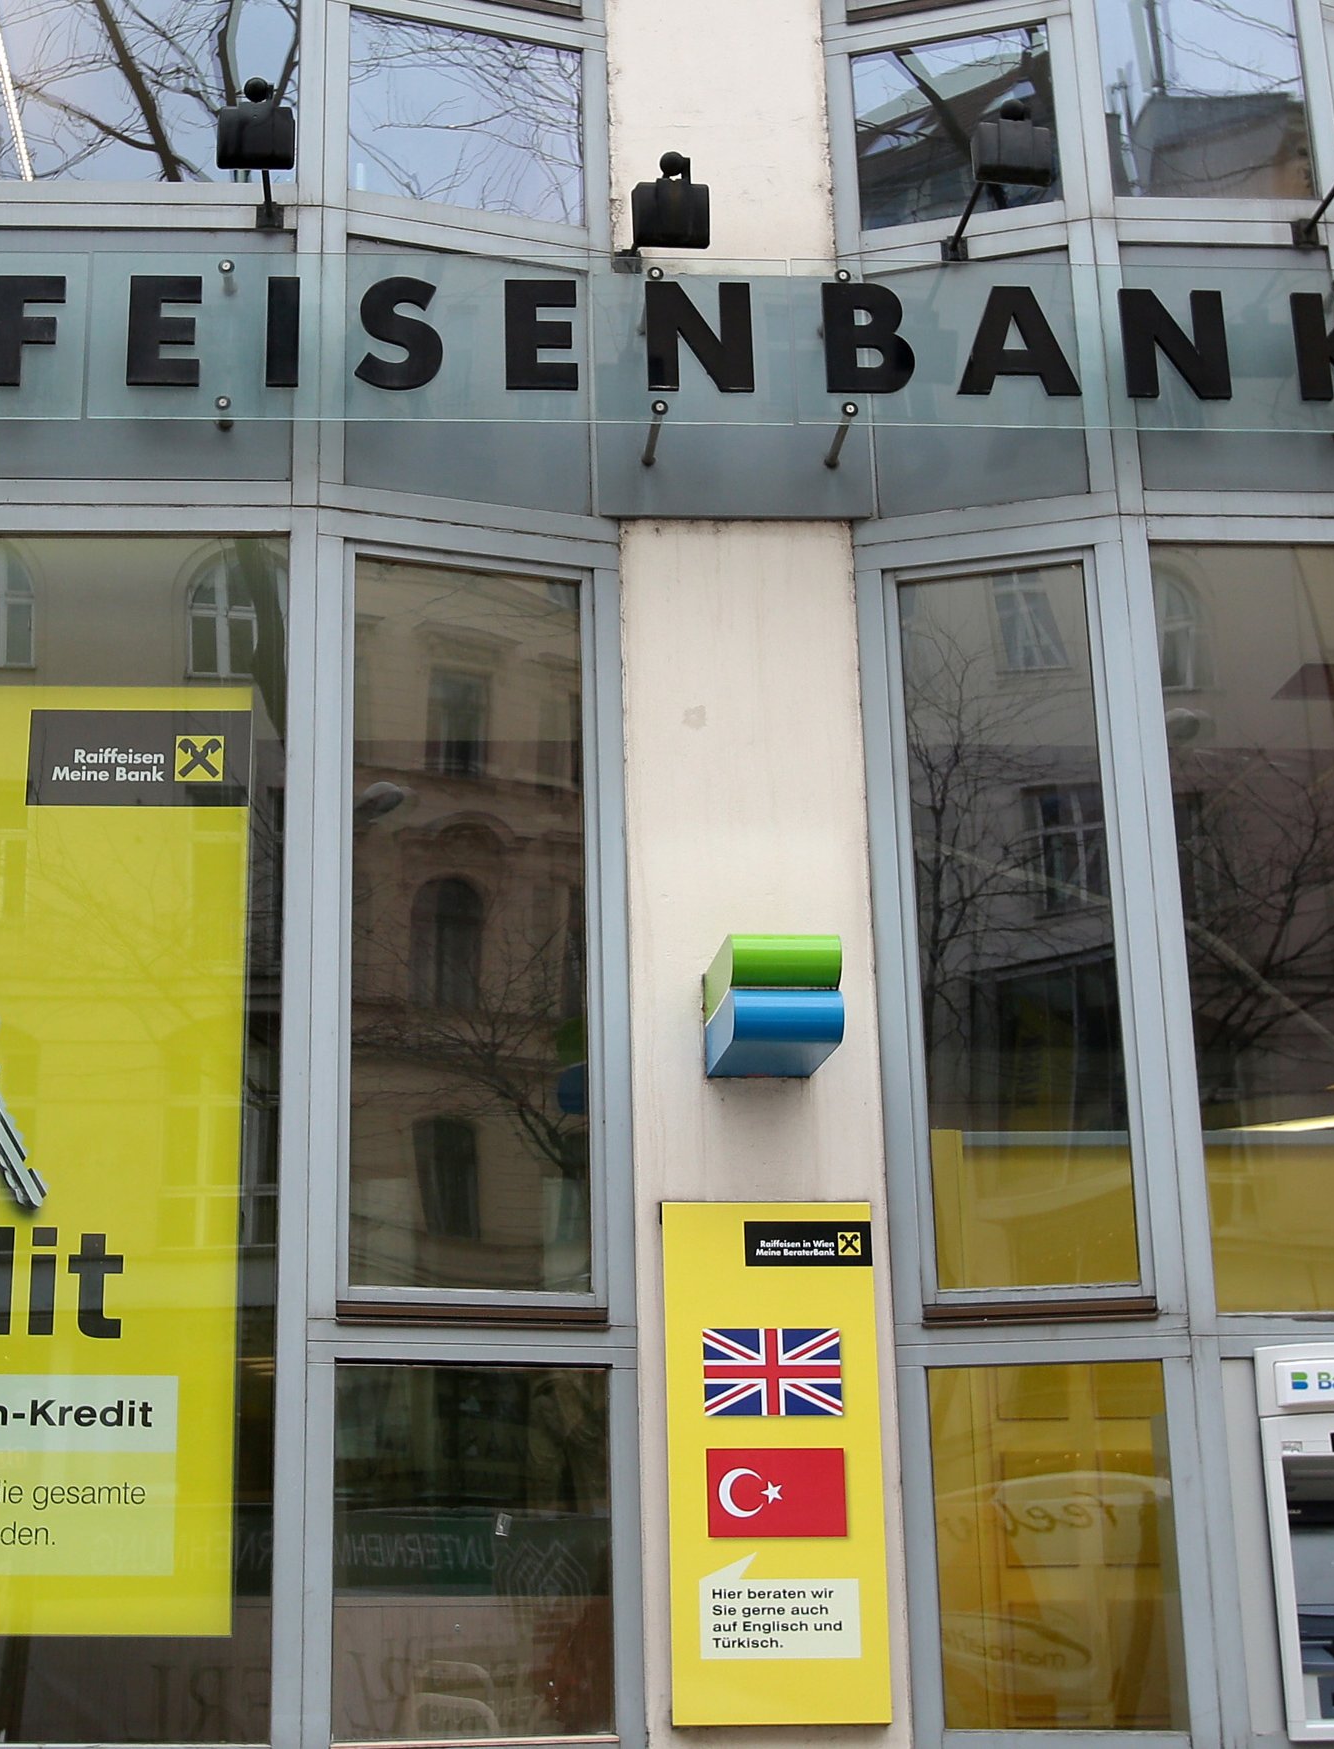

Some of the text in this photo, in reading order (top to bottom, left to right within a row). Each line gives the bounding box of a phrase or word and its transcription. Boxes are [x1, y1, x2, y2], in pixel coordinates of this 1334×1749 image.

[73, 748, 165, 764] Raiffeisen
[51, 766, 165, 782] Meine Bank
[760, 1239, 835, 1248] Raiffeisen in Wien
[755, 1248, 836, 1257] Meine BeraterBank
[32, 1481, 146, 1511] gesamte
[712, 1588, 834, 1600] Hier beraten wir
[712, 1604, 829, 1619] Sie gerne auch
[712, 1620, 843, 1635] auf Englisch und
[712, 1637, 784, 1649] Türkisch.
